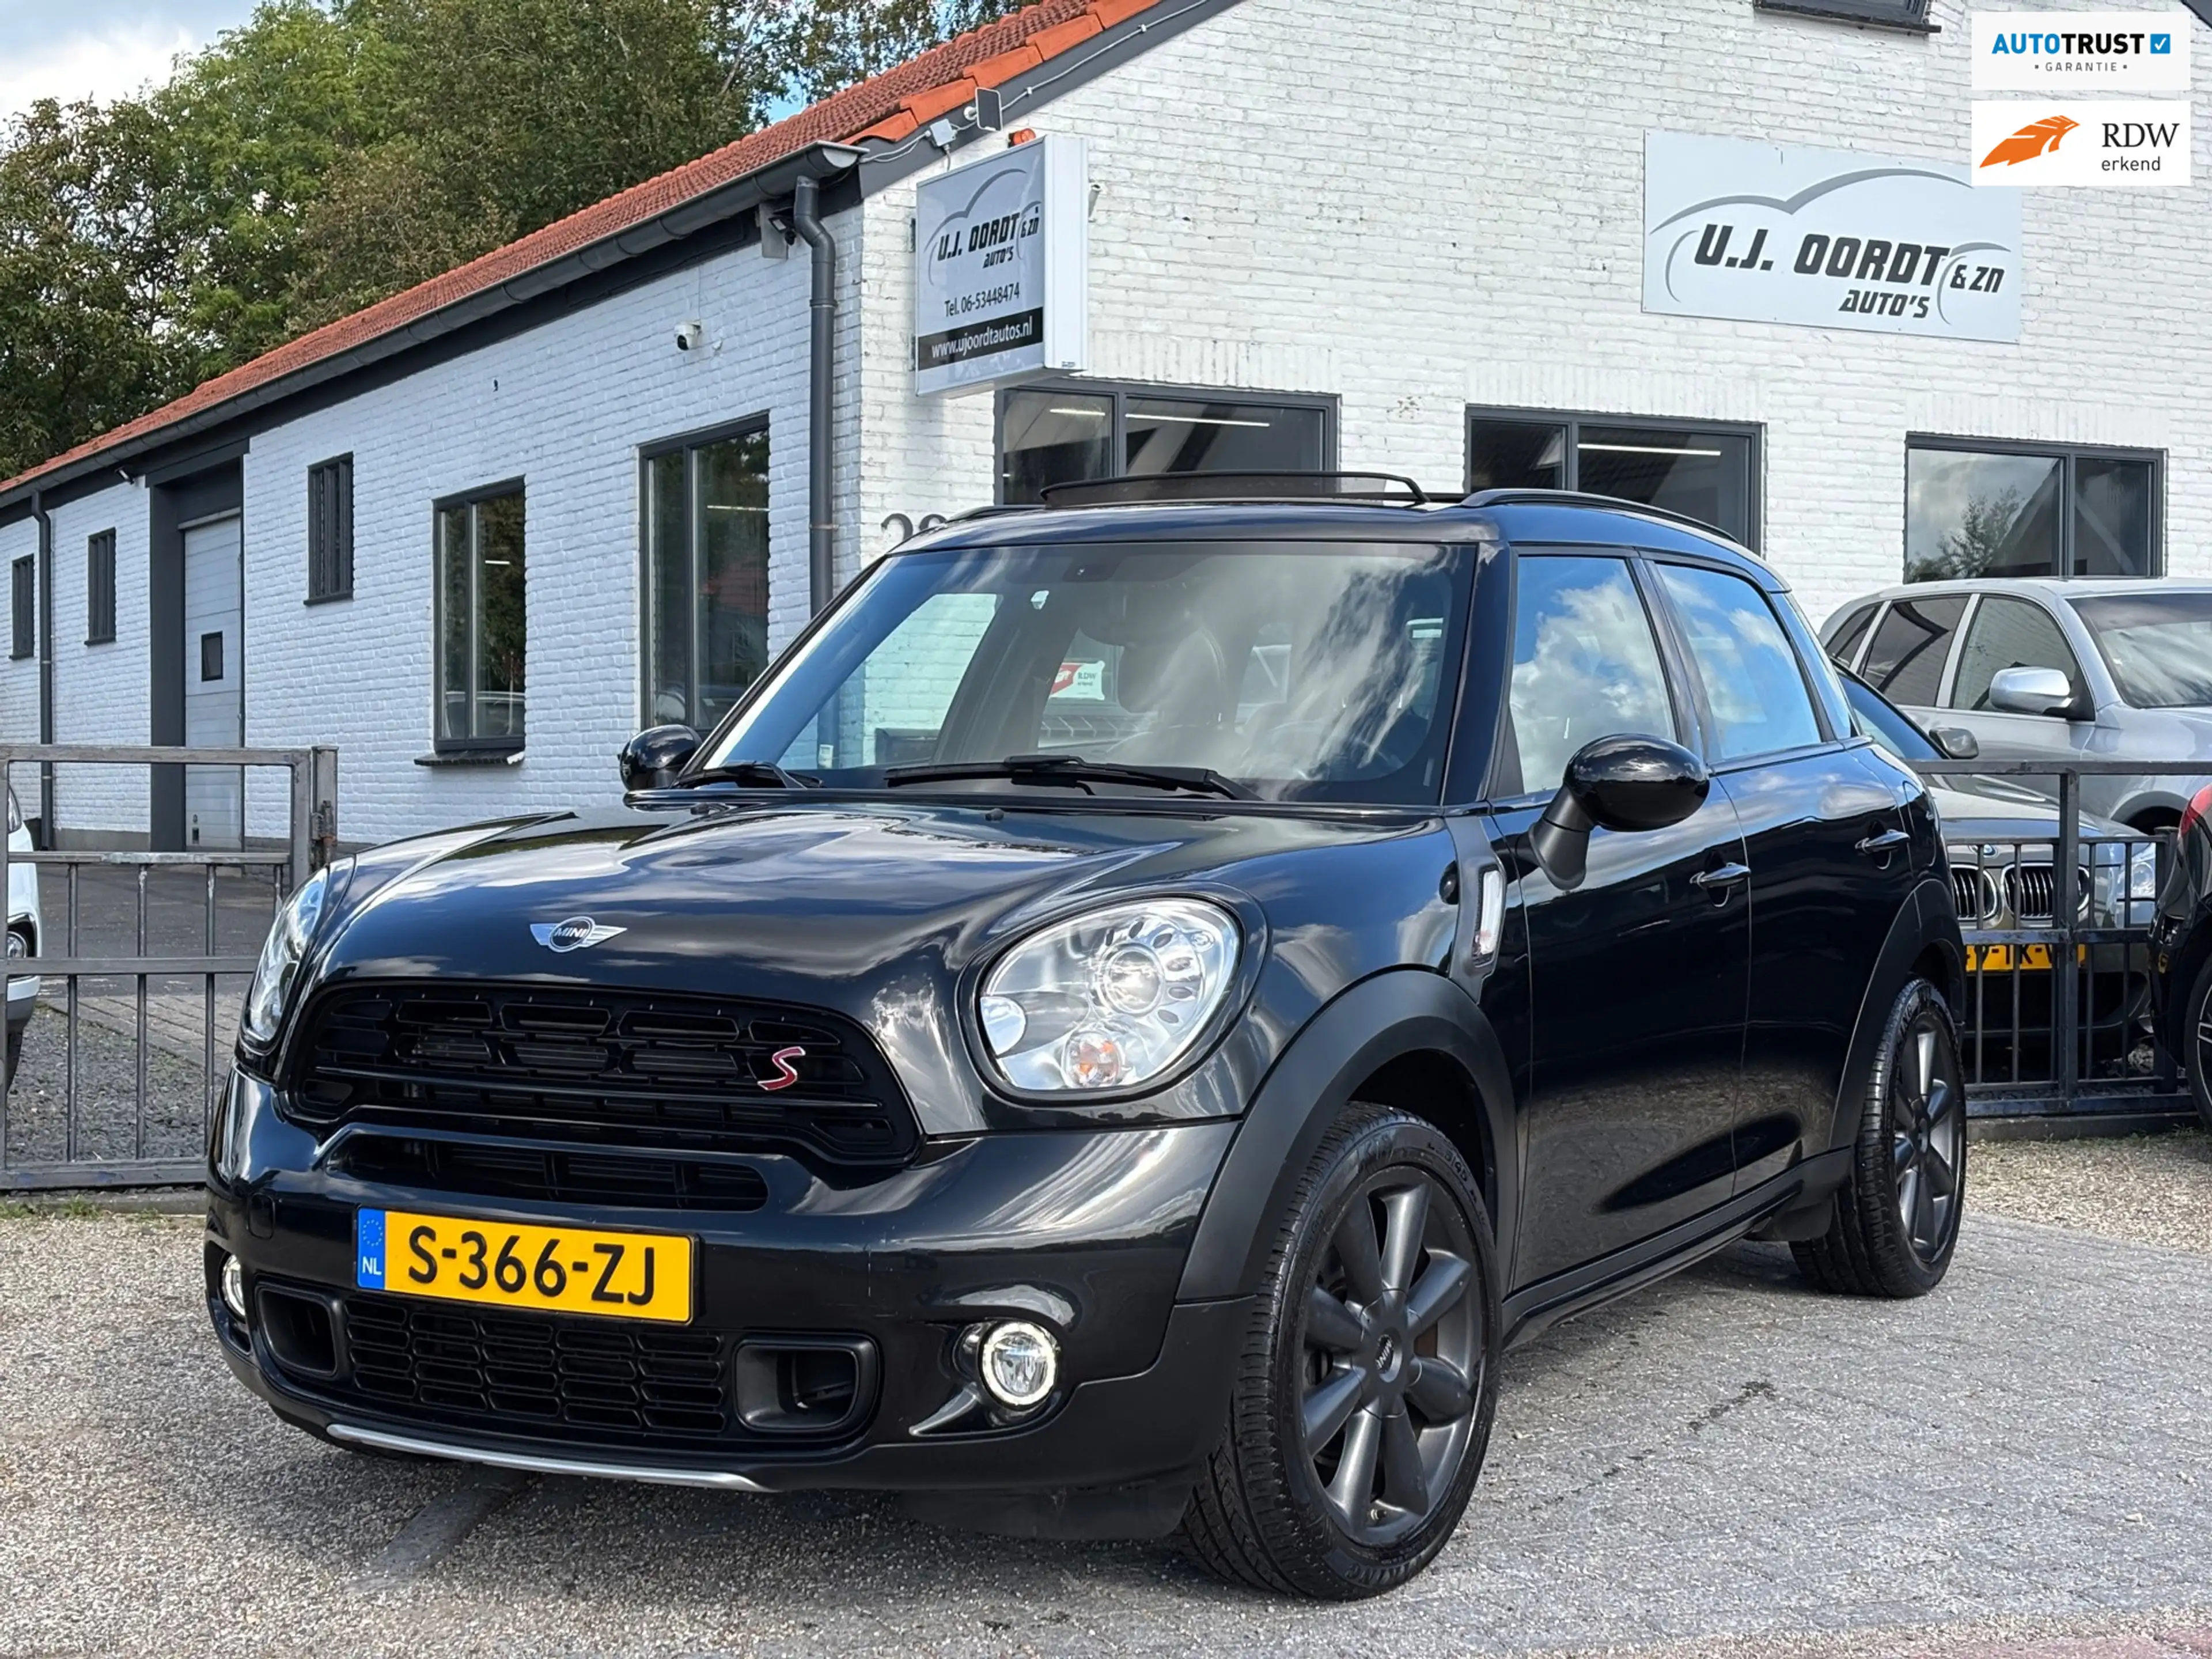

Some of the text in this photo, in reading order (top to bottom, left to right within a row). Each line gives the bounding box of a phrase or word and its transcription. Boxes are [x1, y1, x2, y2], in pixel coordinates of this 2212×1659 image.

[937, 230, 963, 261] U.J.
[968, 212, 1020, 252] OORDT
[1694, 224, 1775, 271] U.J.
[1793, 233, 1952, 287] OORDT
[1950, 264, 1965, 290] &
[944, 282, 1020, 317] Tel. 06-53448474
[932, 316, 1033, 358] www.ujoordtautos.nl
[554, 927, 588, 937] MINI
[757, 1046, 806, 1090] S
[362, 1255, 382, 1277] NL
[408, 1225, 656, 1305] S-366-ZJ
[1375, 1338, 1392, 1370] MINI
